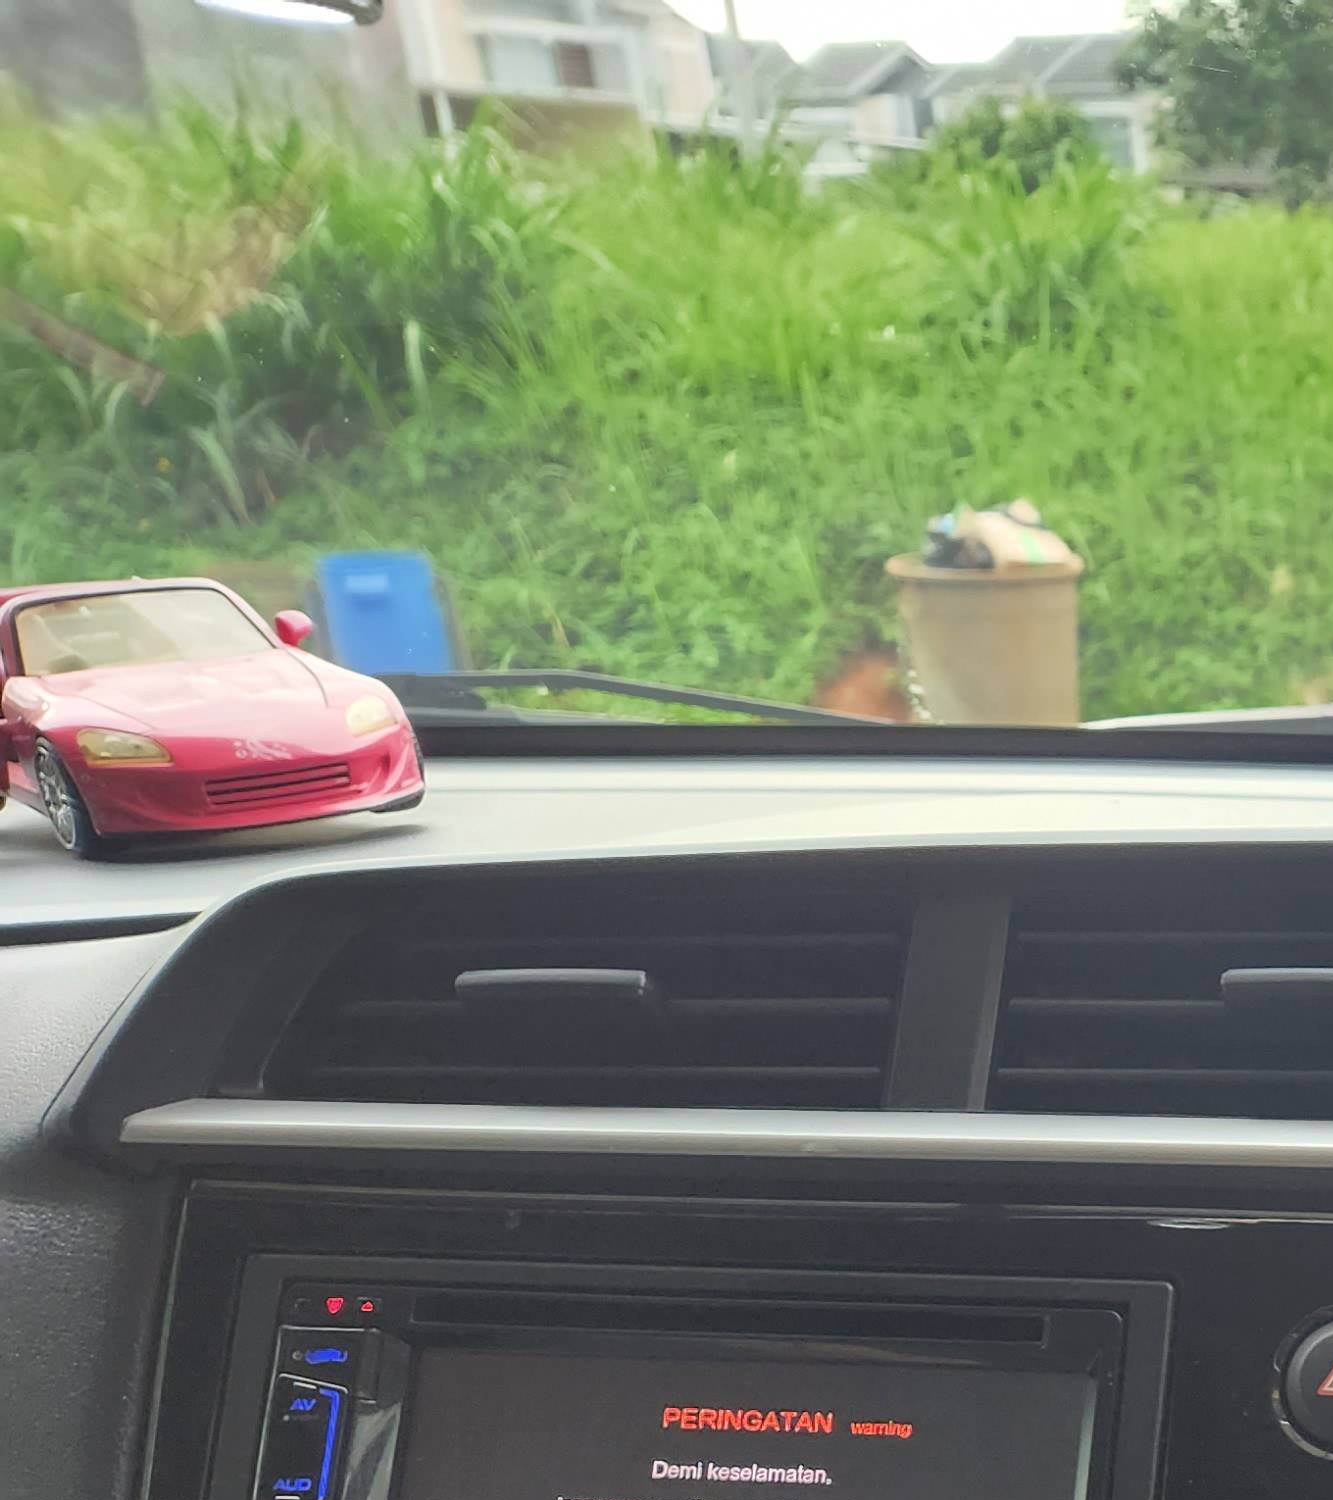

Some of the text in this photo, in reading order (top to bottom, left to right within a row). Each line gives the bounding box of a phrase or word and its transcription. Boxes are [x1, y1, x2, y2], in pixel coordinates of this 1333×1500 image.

[662, 1407, 913, 1439] PERINGATAN warning
[651, 1460, 703, 1480] Demi
